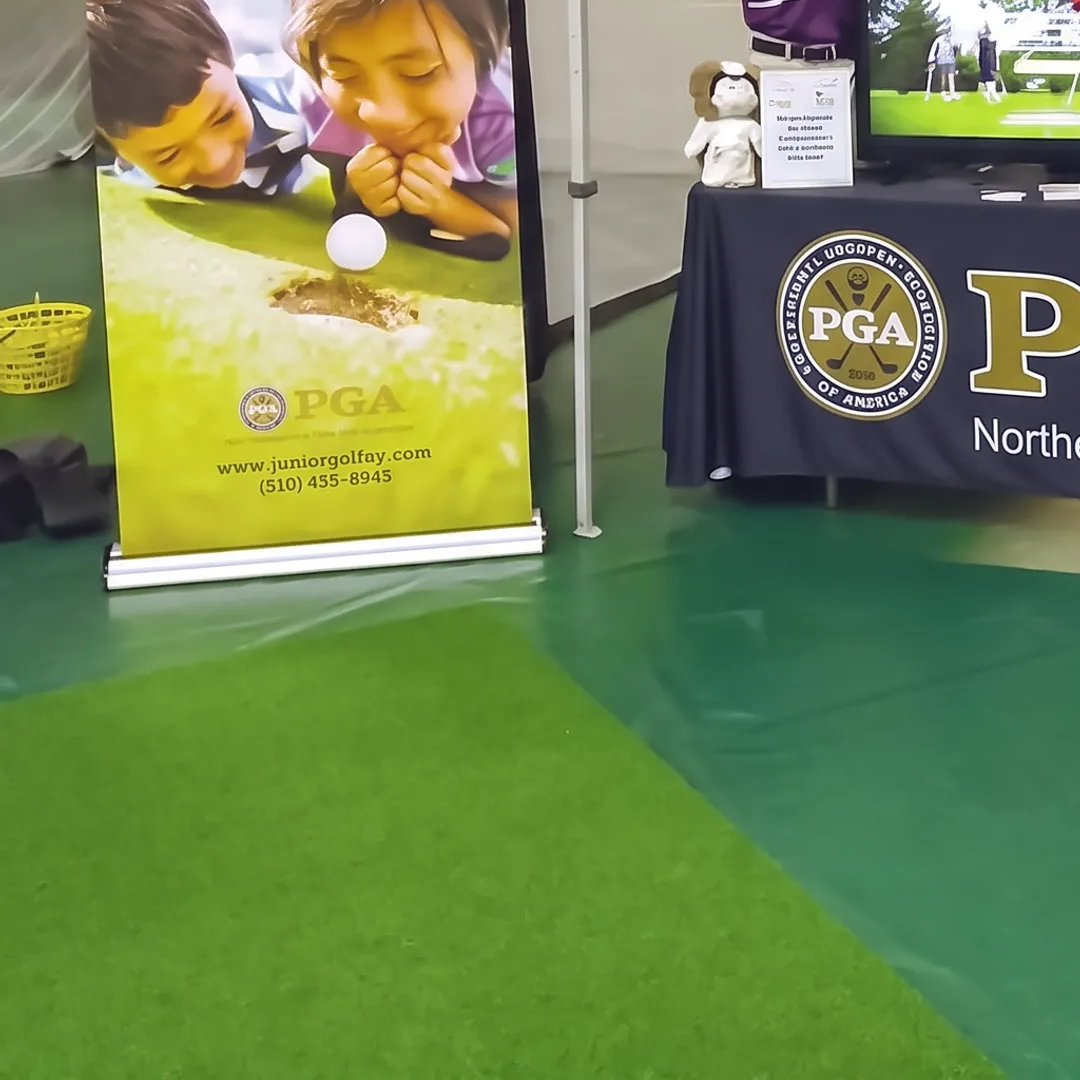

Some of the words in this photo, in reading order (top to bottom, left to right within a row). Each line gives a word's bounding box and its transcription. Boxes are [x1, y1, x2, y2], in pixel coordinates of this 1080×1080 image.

[807, 306, 915, 347] PGA
[294, 384, 406, 420] PGA
[818, 380, 839, 397] OF
[259, 475, 303, 496] (510)
[307, 469, 392, 489] 455-8945
